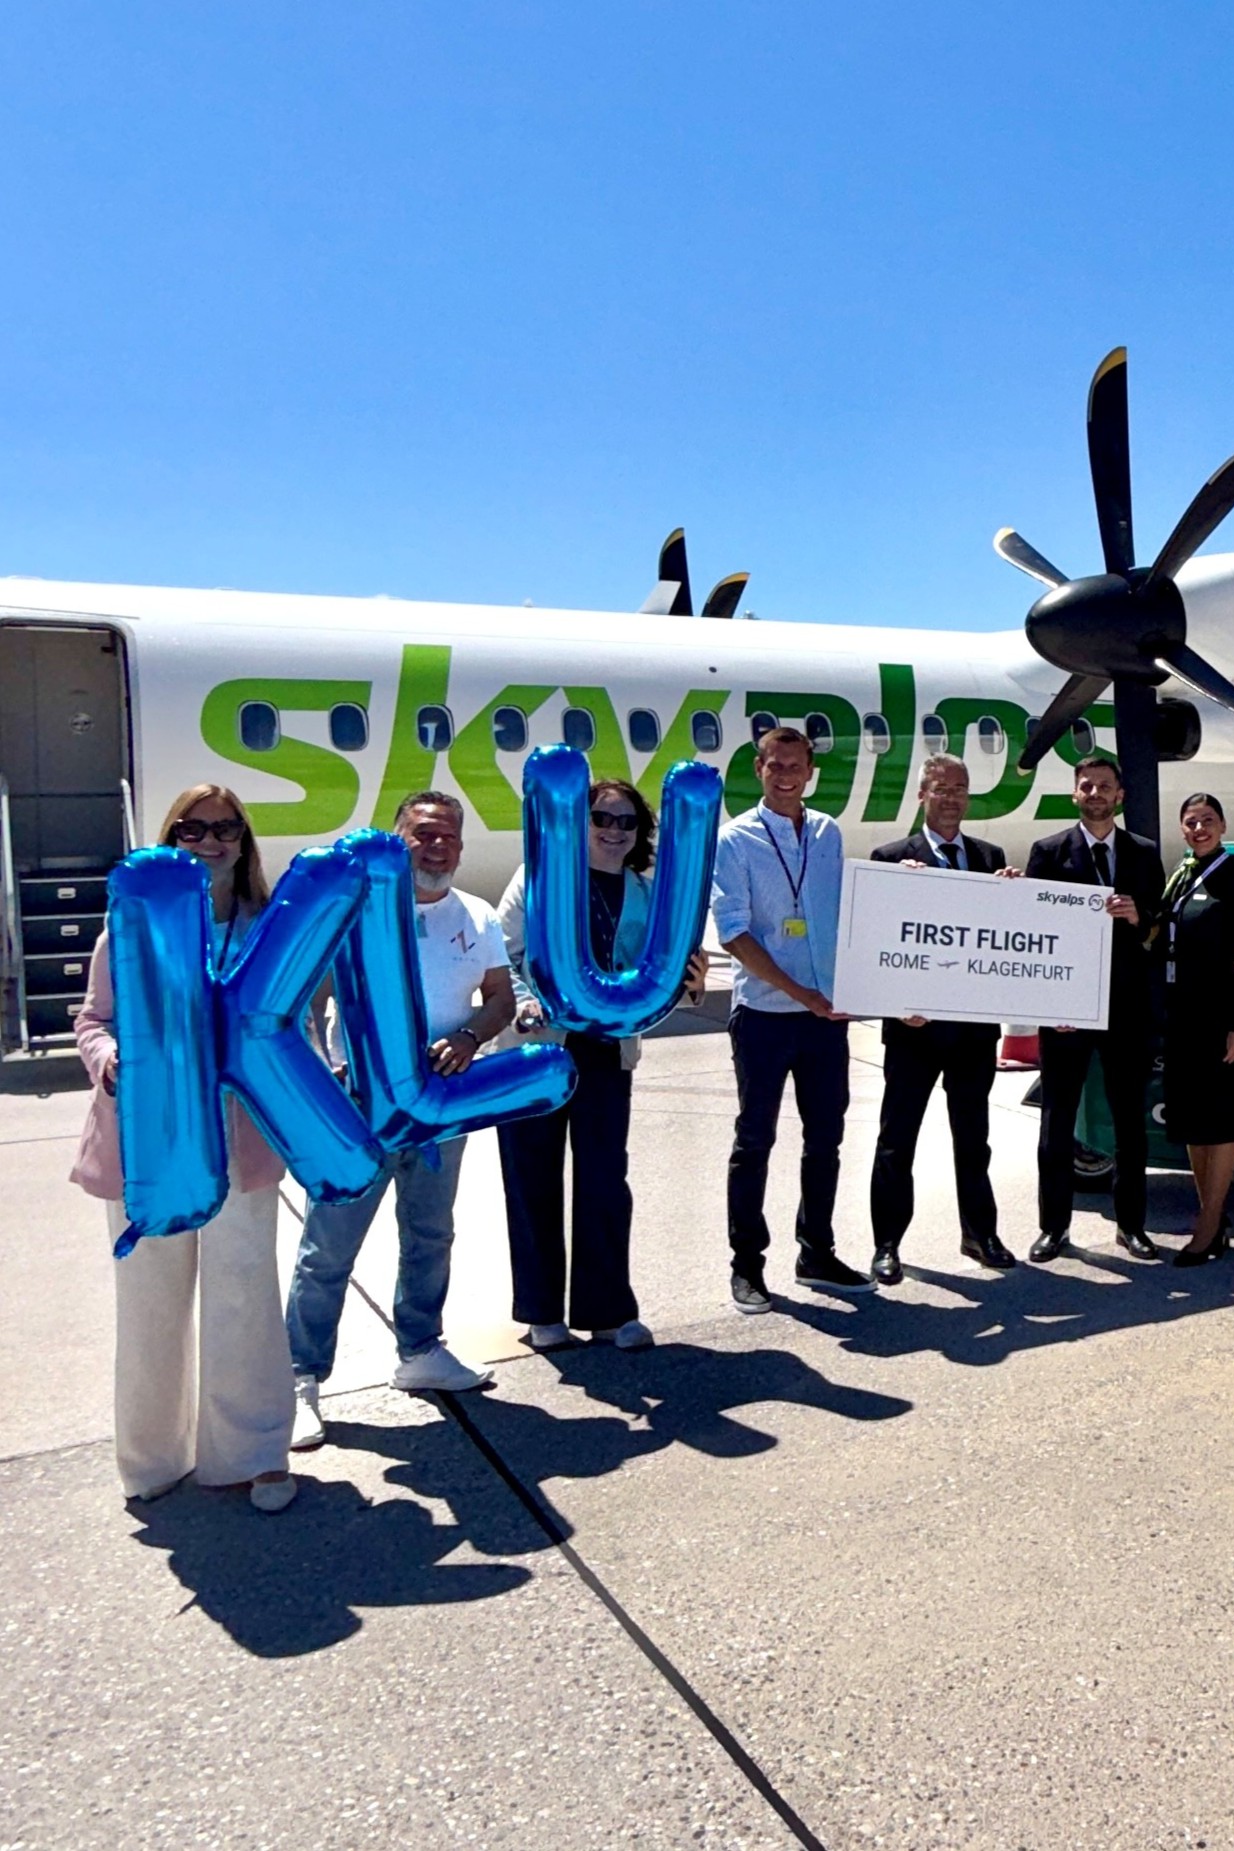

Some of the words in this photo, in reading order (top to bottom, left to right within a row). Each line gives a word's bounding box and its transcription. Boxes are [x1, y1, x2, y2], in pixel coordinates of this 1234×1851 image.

[1036, 891, 1085, 906] skyalps
[900, 921, 971, 948] FIRST
[976, 929, 1059, 955] FLIGHT
[879, 951, 931, 970] ROME
[967, 959, 1074, 981] KLAGENFURT
